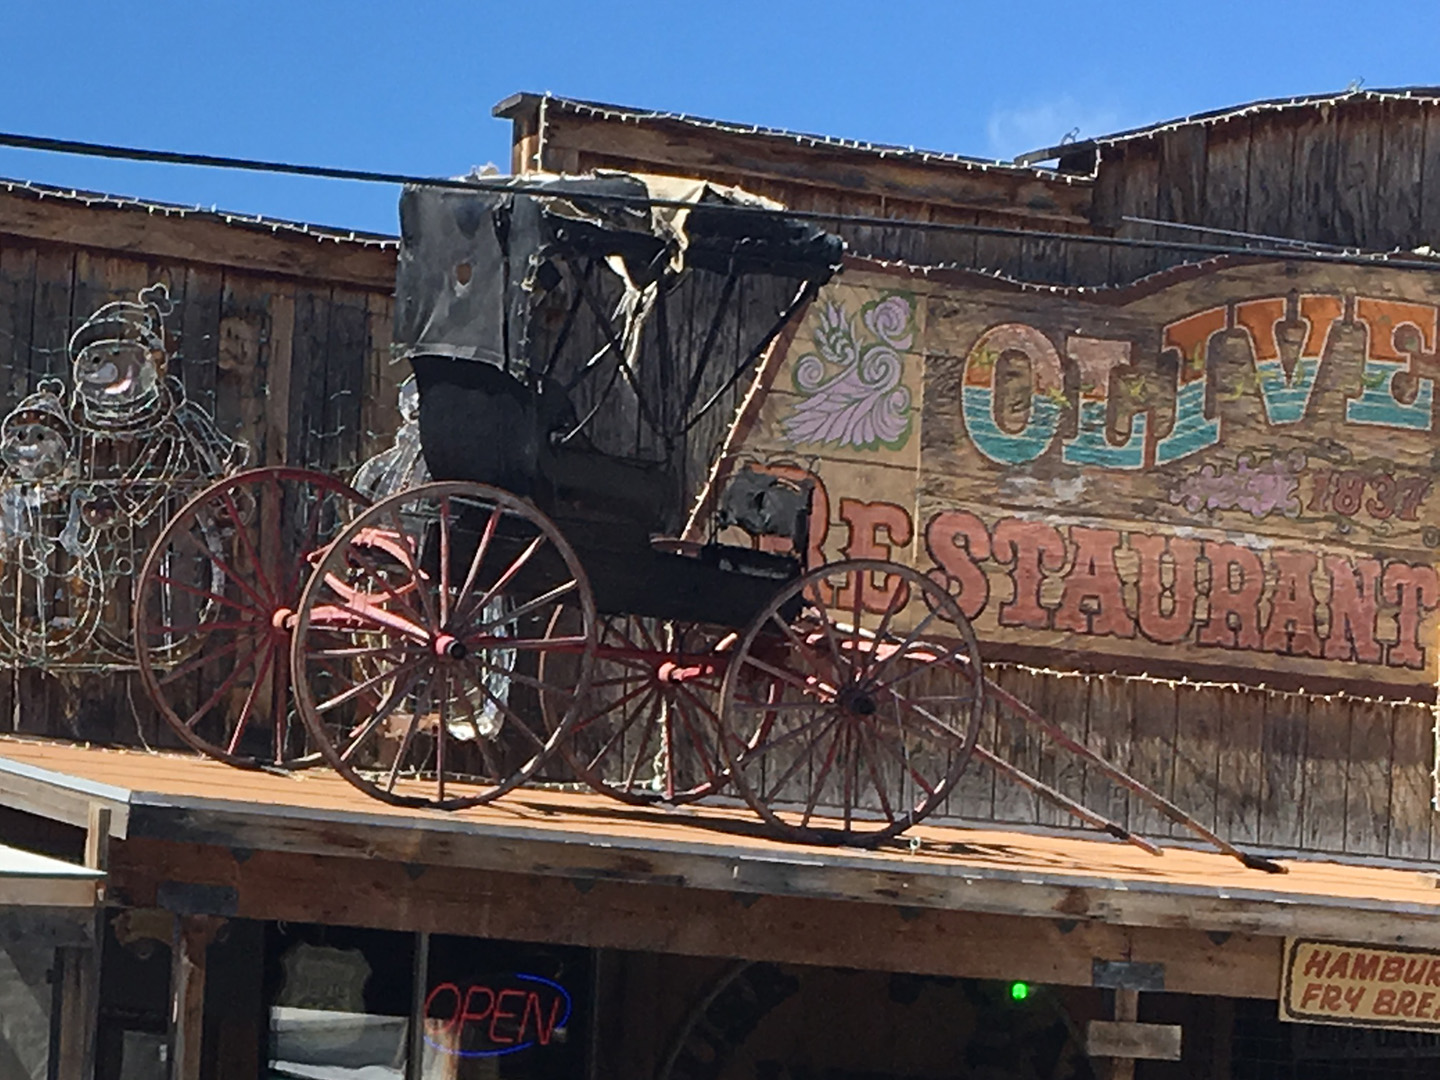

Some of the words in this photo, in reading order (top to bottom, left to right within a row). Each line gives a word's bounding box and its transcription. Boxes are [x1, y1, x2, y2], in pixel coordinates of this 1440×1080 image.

[961, 296, 1439, 470] OLIVE
[423, 982, 560, 1045] OPEN
[1299, 982, 1366, 1013] FRY
